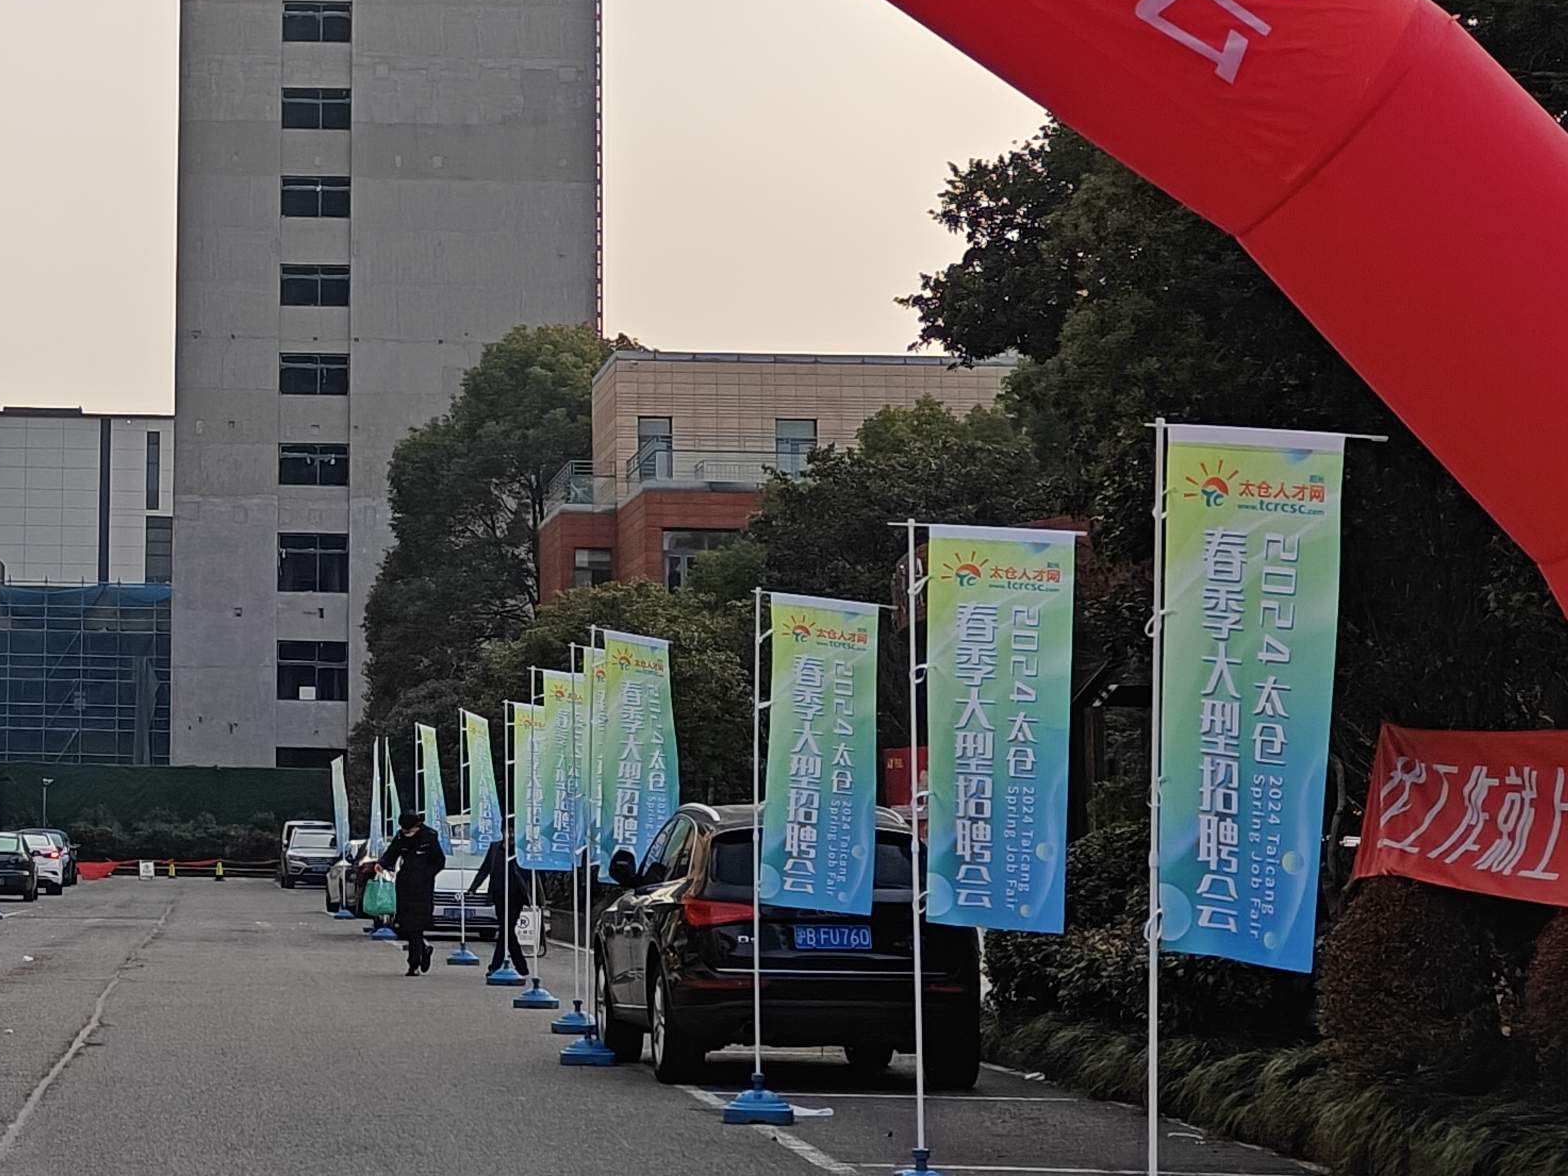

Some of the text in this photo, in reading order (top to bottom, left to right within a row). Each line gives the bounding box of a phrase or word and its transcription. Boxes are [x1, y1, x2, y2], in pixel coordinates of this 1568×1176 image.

[1238, 480, 1325, 503] 太仓人才网
[989, 566, 1061, 584] 太仓人才网
[612, 679, 642, 851] 春季大型招聘
[783, 655, 824, 895] 春季大型招聘会
[954, 603, 998, 909] 春季大型招聘会
[1196, 527, 1248, 934] 春季大型招聘会
[1003, 786, 1019, 910] Spring Job Fair
[1018, 786, 1035, 892] 2024 Taicang
[1248, 774, 1265, 939] Spring Job Fair
[1261, 775, 1283, 916] 2024 Taicang
